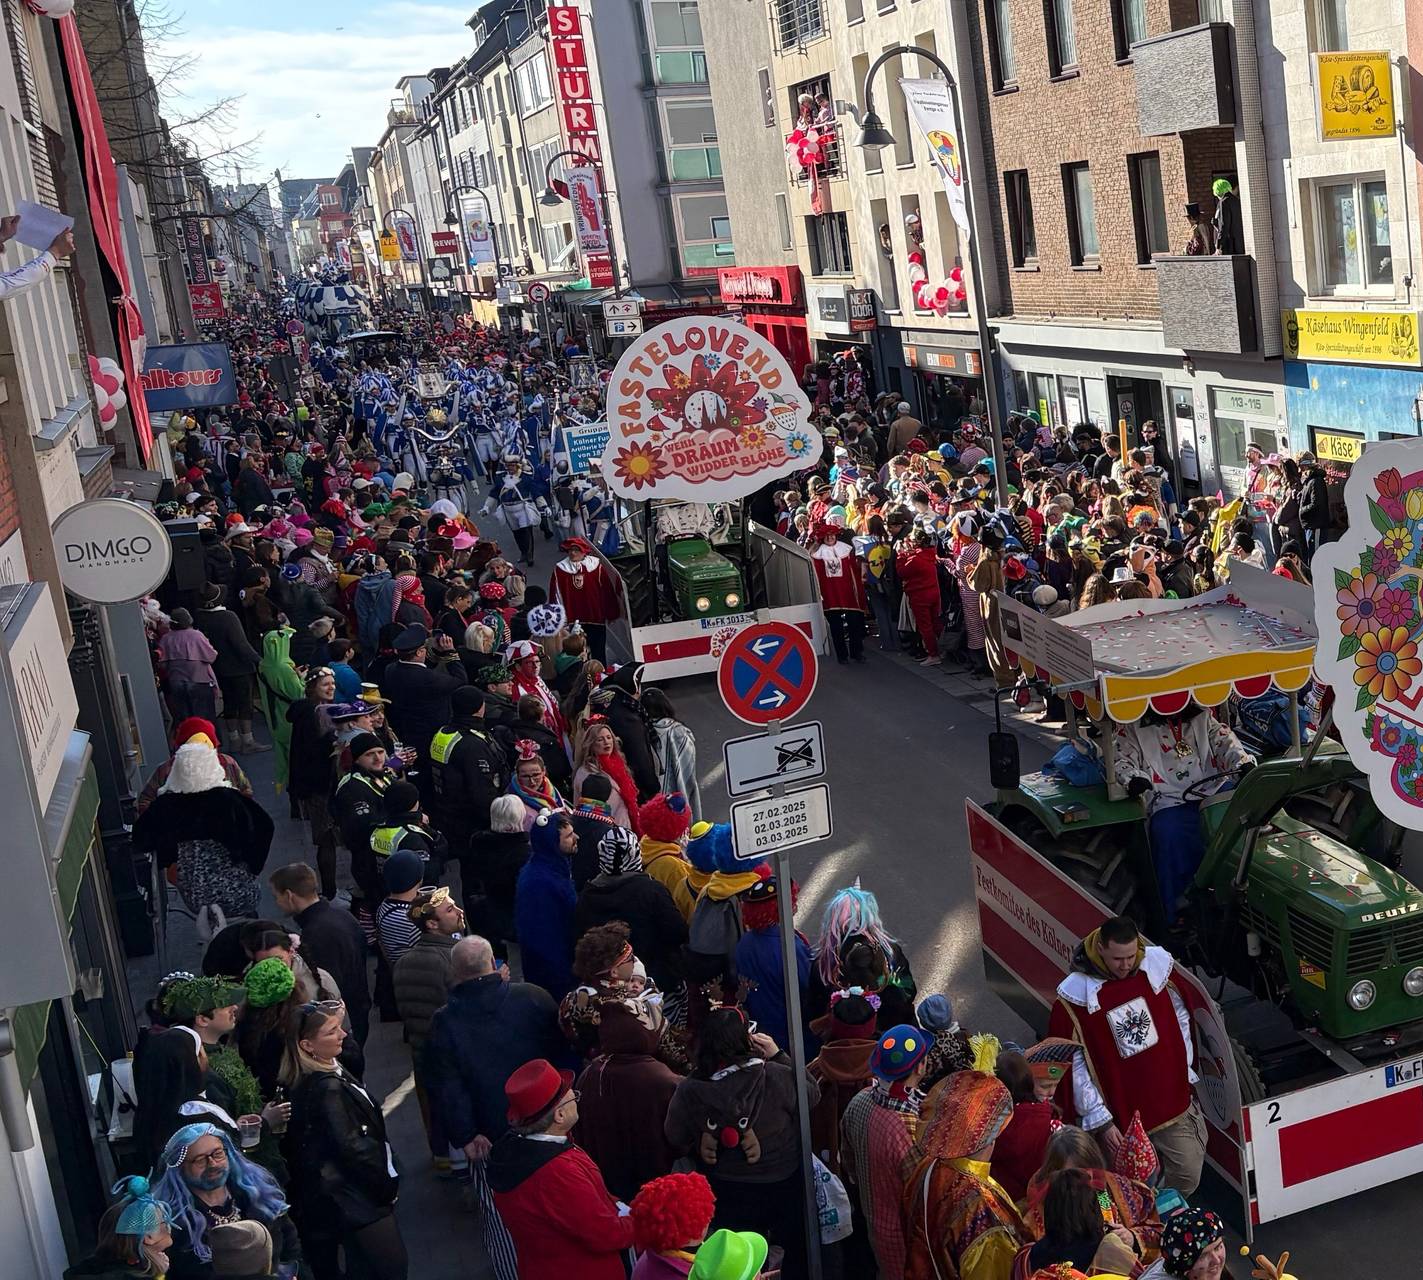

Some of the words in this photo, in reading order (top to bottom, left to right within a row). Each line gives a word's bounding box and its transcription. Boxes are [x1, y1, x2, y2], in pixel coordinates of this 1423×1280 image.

[556, 10, 598, 159] STÜRM
[433, 238, 457, 248] REWE
[849, 292, 872, 304] NEXT
[851, 304, 874, 318] DOOR
[1306, 316, 1342, 336] Käsehaus
[1343, 316, 1390, 341] Wingenfeld
[137, 368, 223, 390] alltours
[618, 326, 783, 437] FASTELOVEND
[664, 437, 696, 452] WENN
[672, 437, 741, 468] DRÄUM
[1330, 436, 1354, 459] Käse
[687, 455, 739, 476] WIDDER
[740, 446, 786, 468] BLÖHE
[65, 536, 152, 562] DIMGO
[654, 645, 661, 655] 1
[753, 801, 806, 822] 27.02.2025
[754, 813, 807, 834] 02.03.2025
[756, 825, 808, 846] 03.03.2025
[976, 864, 1026, 924] Festkomitee
[1026, 908, 1041, 938] des
[1041, 919, 1071, 963] Kölner
[1360, 903, 1420, 922] DEUTZ
[1396, 1066, 1404, 1082] K
[1267, 1102, 1282, 1125] 2
